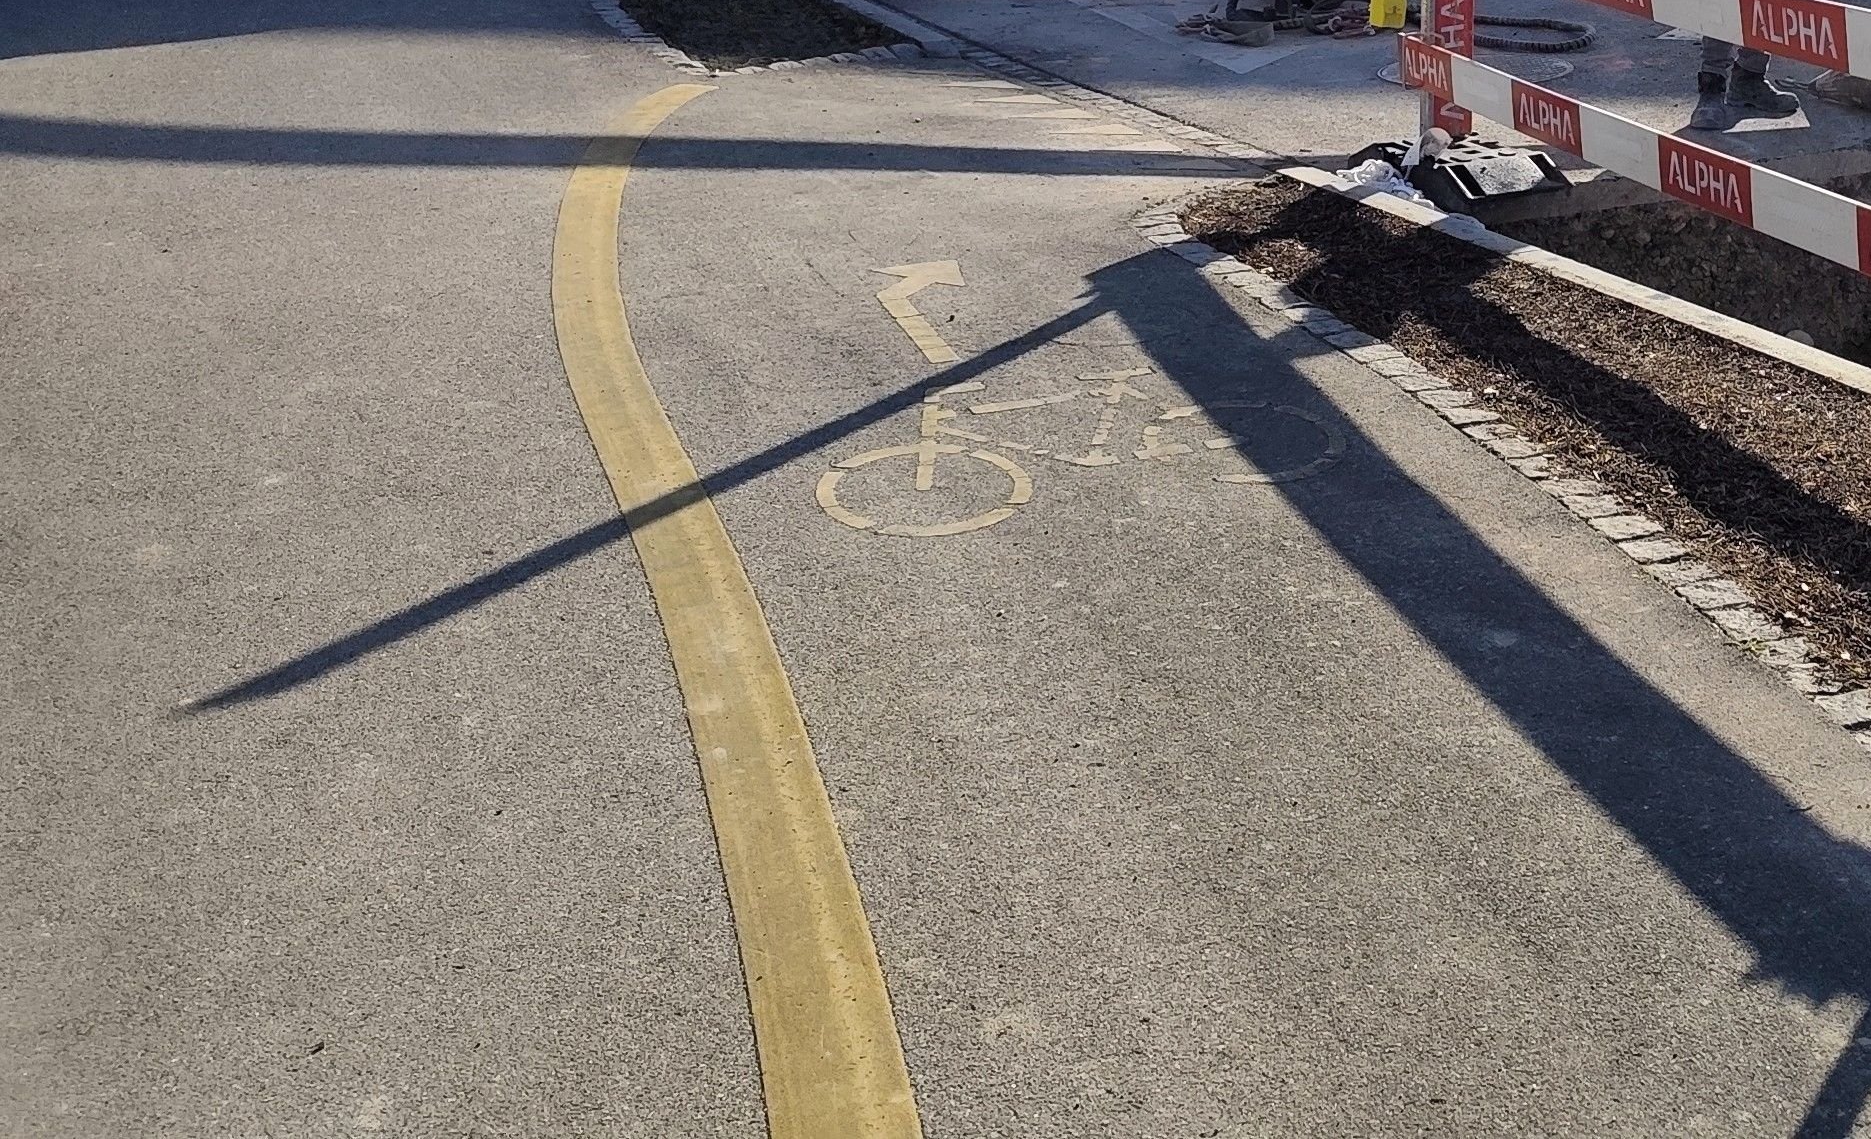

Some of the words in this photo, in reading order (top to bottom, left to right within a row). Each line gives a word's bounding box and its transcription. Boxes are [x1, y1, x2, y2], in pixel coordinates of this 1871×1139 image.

[1404, 45, 1449, 93] ALPHA
[1518, 92, 1577, 147] ALPHA
[1668, 150, 1744, 214] ALPHA
